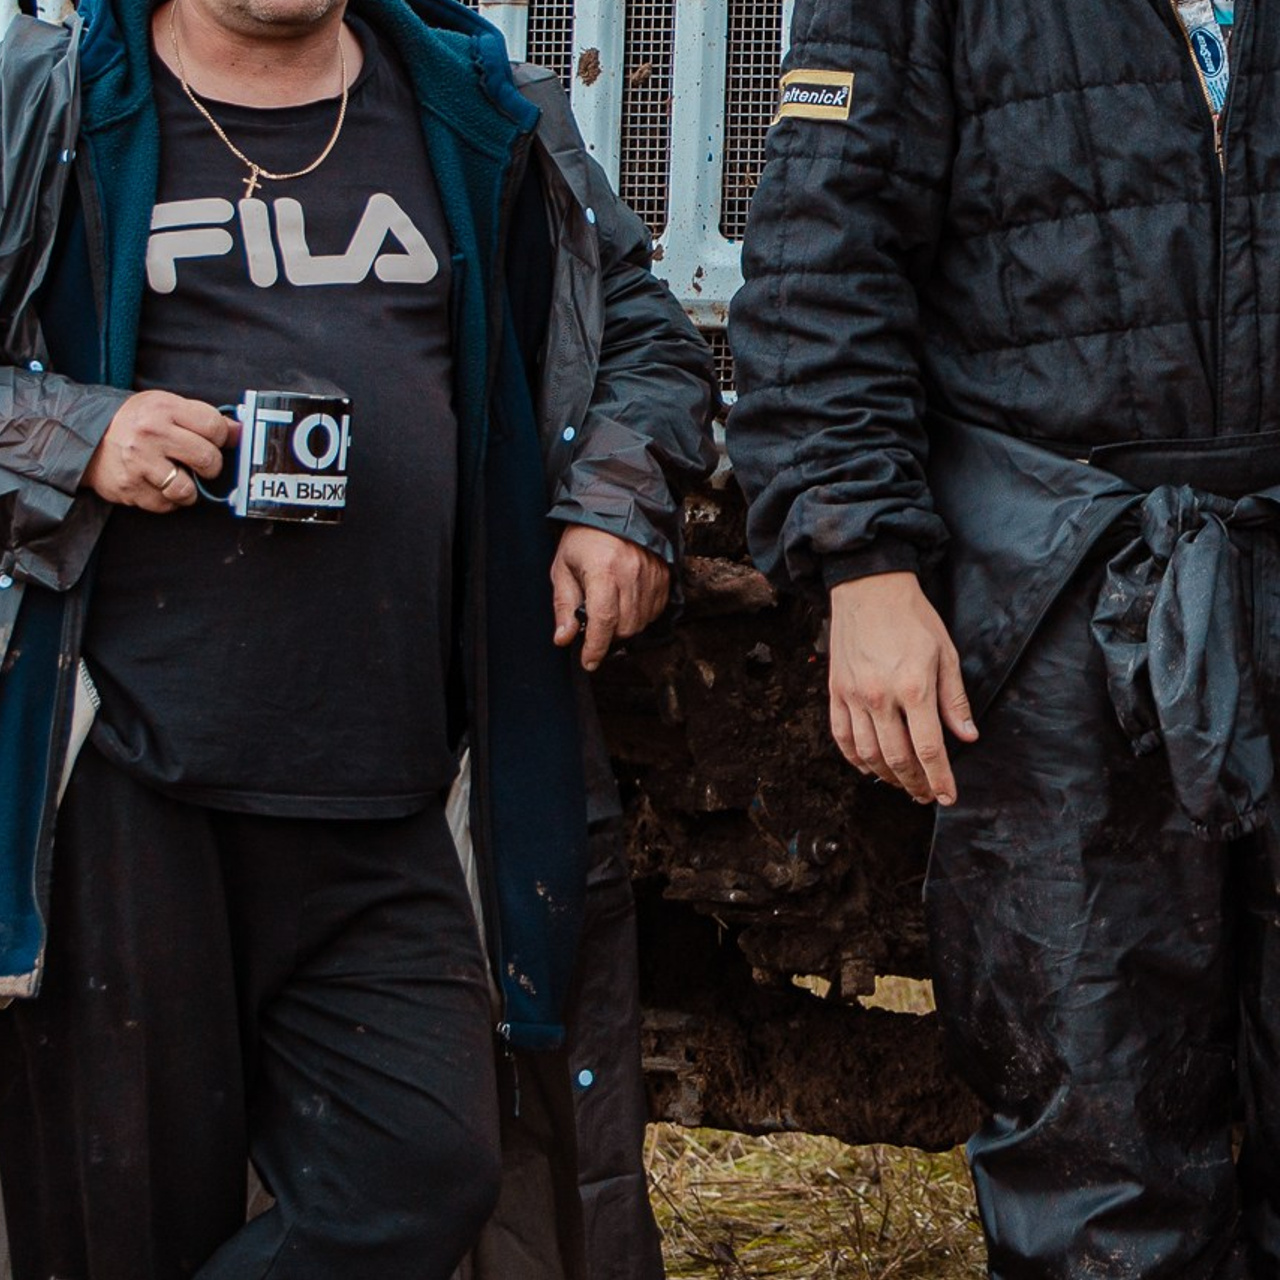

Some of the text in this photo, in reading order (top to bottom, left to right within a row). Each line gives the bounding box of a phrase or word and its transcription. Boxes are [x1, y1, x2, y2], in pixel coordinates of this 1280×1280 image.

[782, 86, 848, 106] eltenick
[146, 193, 438, 293] FILA
[261, 480, 346, 501] НА ВЫЖ
